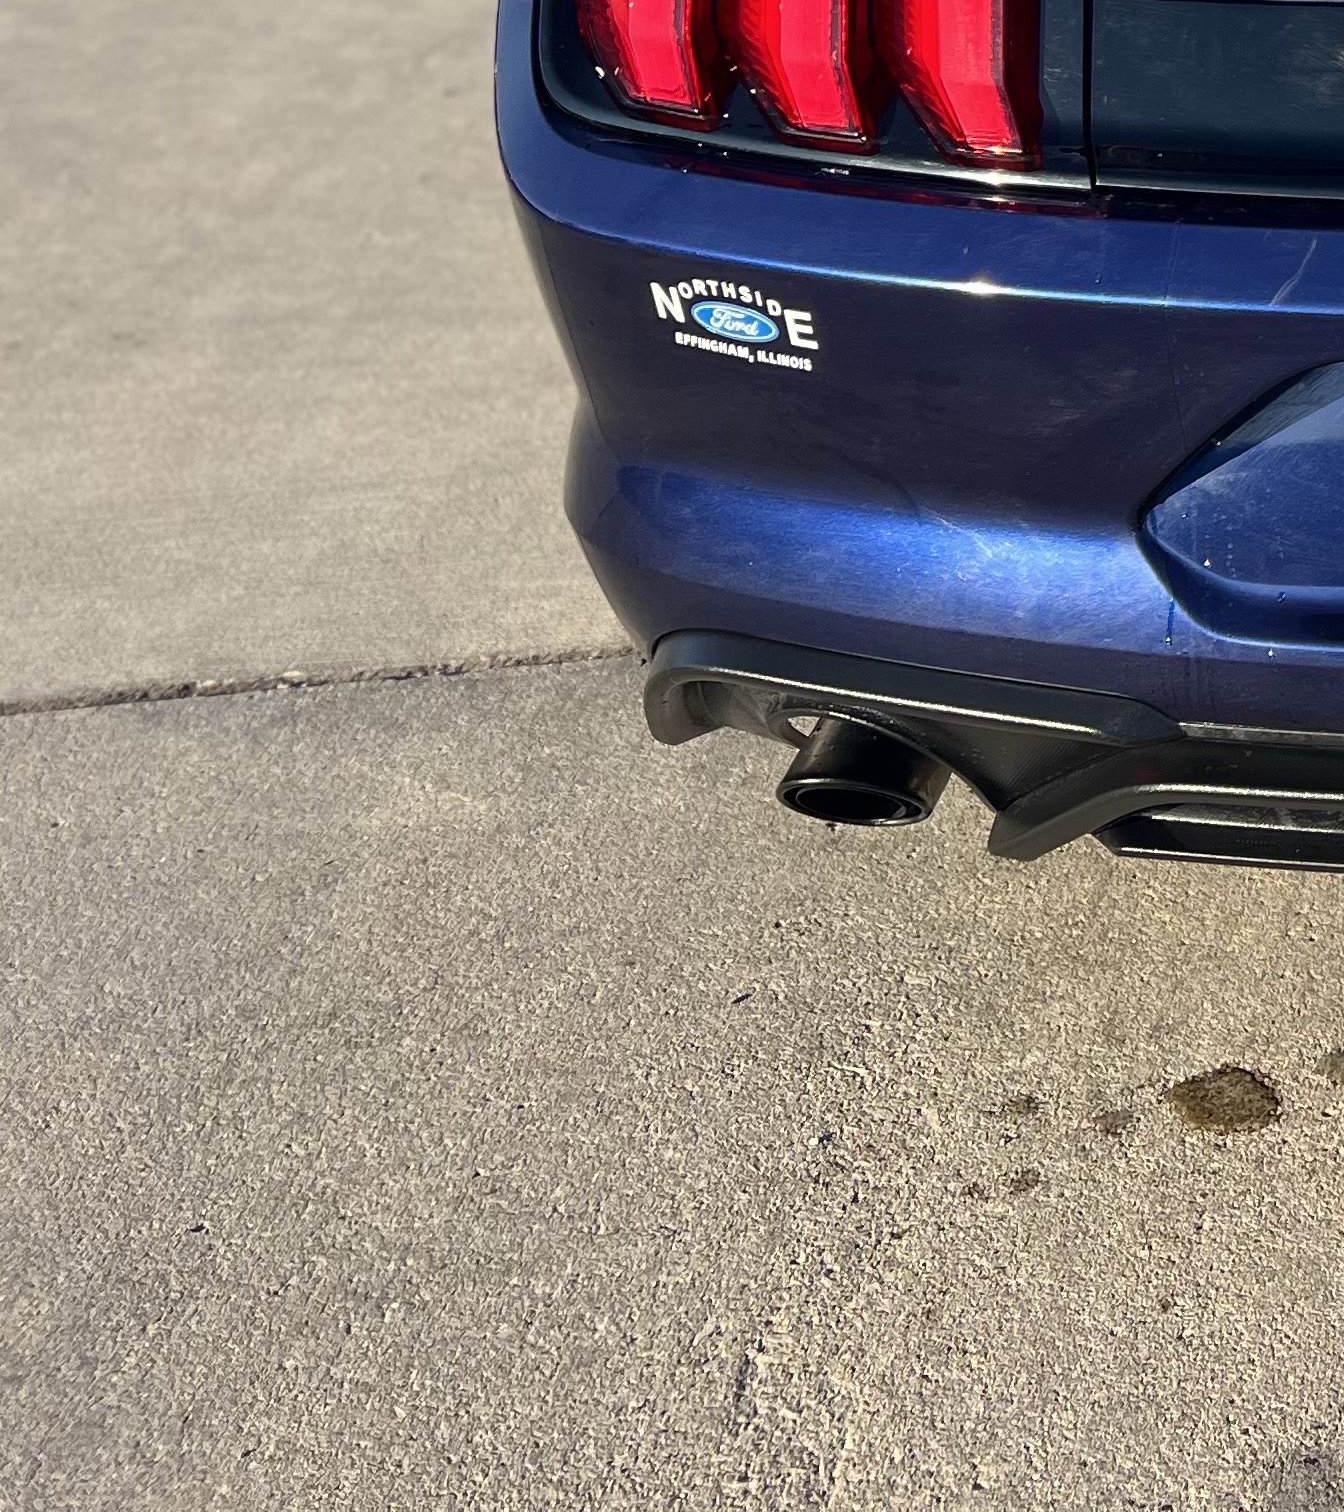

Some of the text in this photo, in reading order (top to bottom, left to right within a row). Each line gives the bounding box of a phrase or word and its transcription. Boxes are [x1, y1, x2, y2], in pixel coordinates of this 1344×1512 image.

[650, 278, 819, 350] NORTHSIDE
[709, 307, 759, 336] Ford
[674, 331, 813, 371] EFFINGHAM, ILLINOIS
